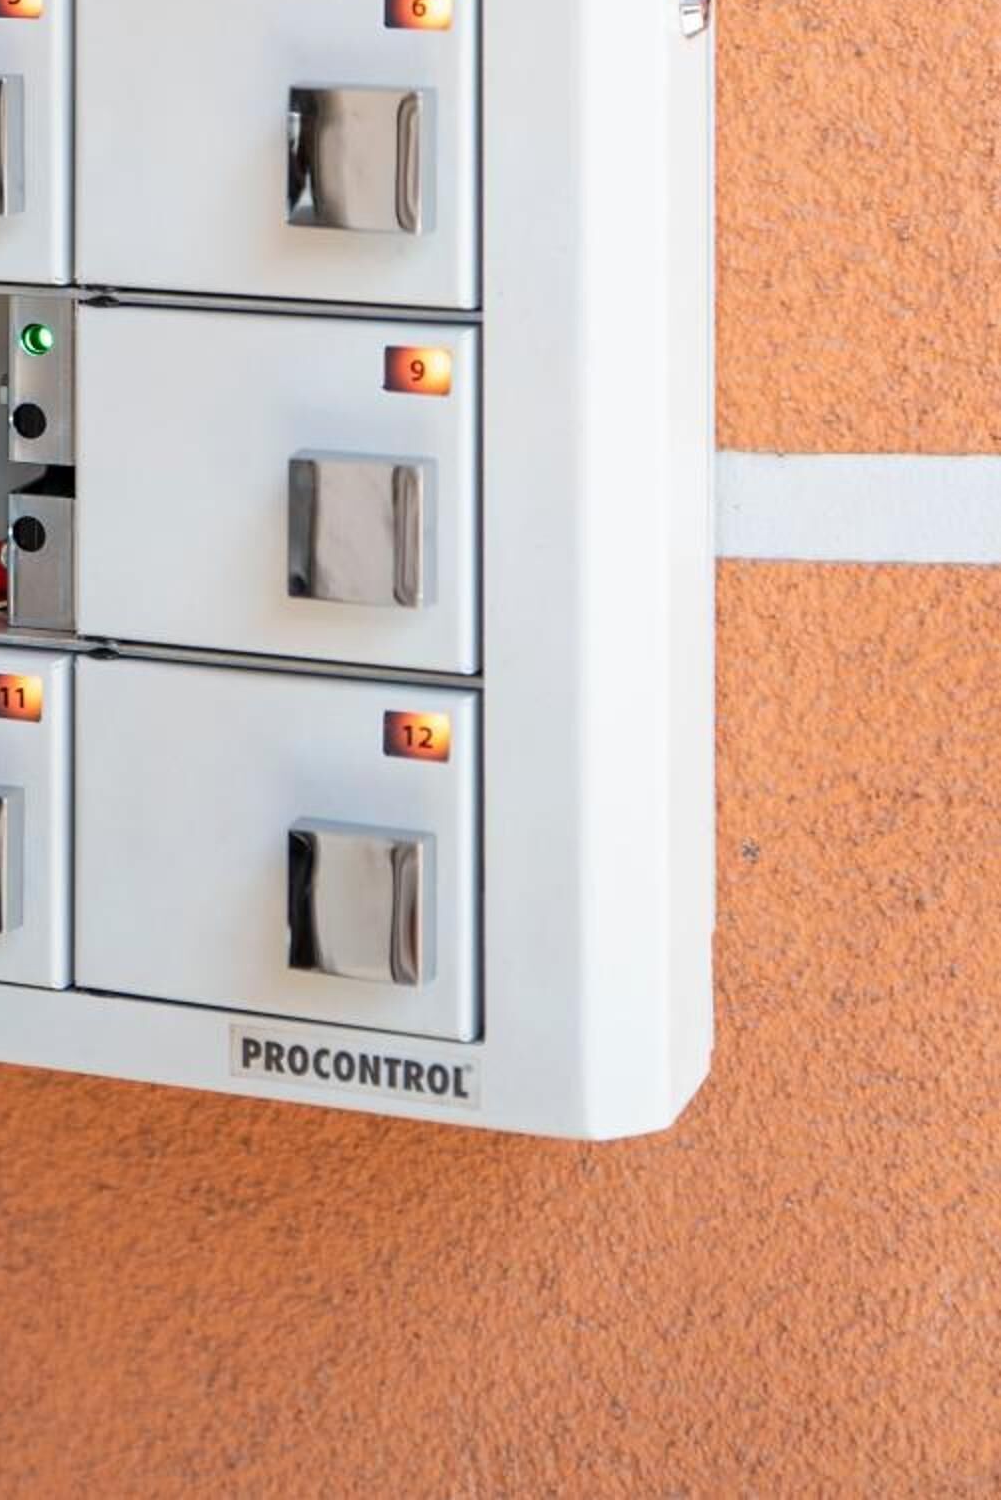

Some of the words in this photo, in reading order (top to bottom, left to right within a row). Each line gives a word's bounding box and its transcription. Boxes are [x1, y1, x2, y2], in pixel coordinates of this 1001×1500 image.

[410, 359, 425, 381] 9
[0, 687, 25, 709] 11
[403, 725, 433, 749] 12
[242, 1037, 469, 1099] PROCONTROL
